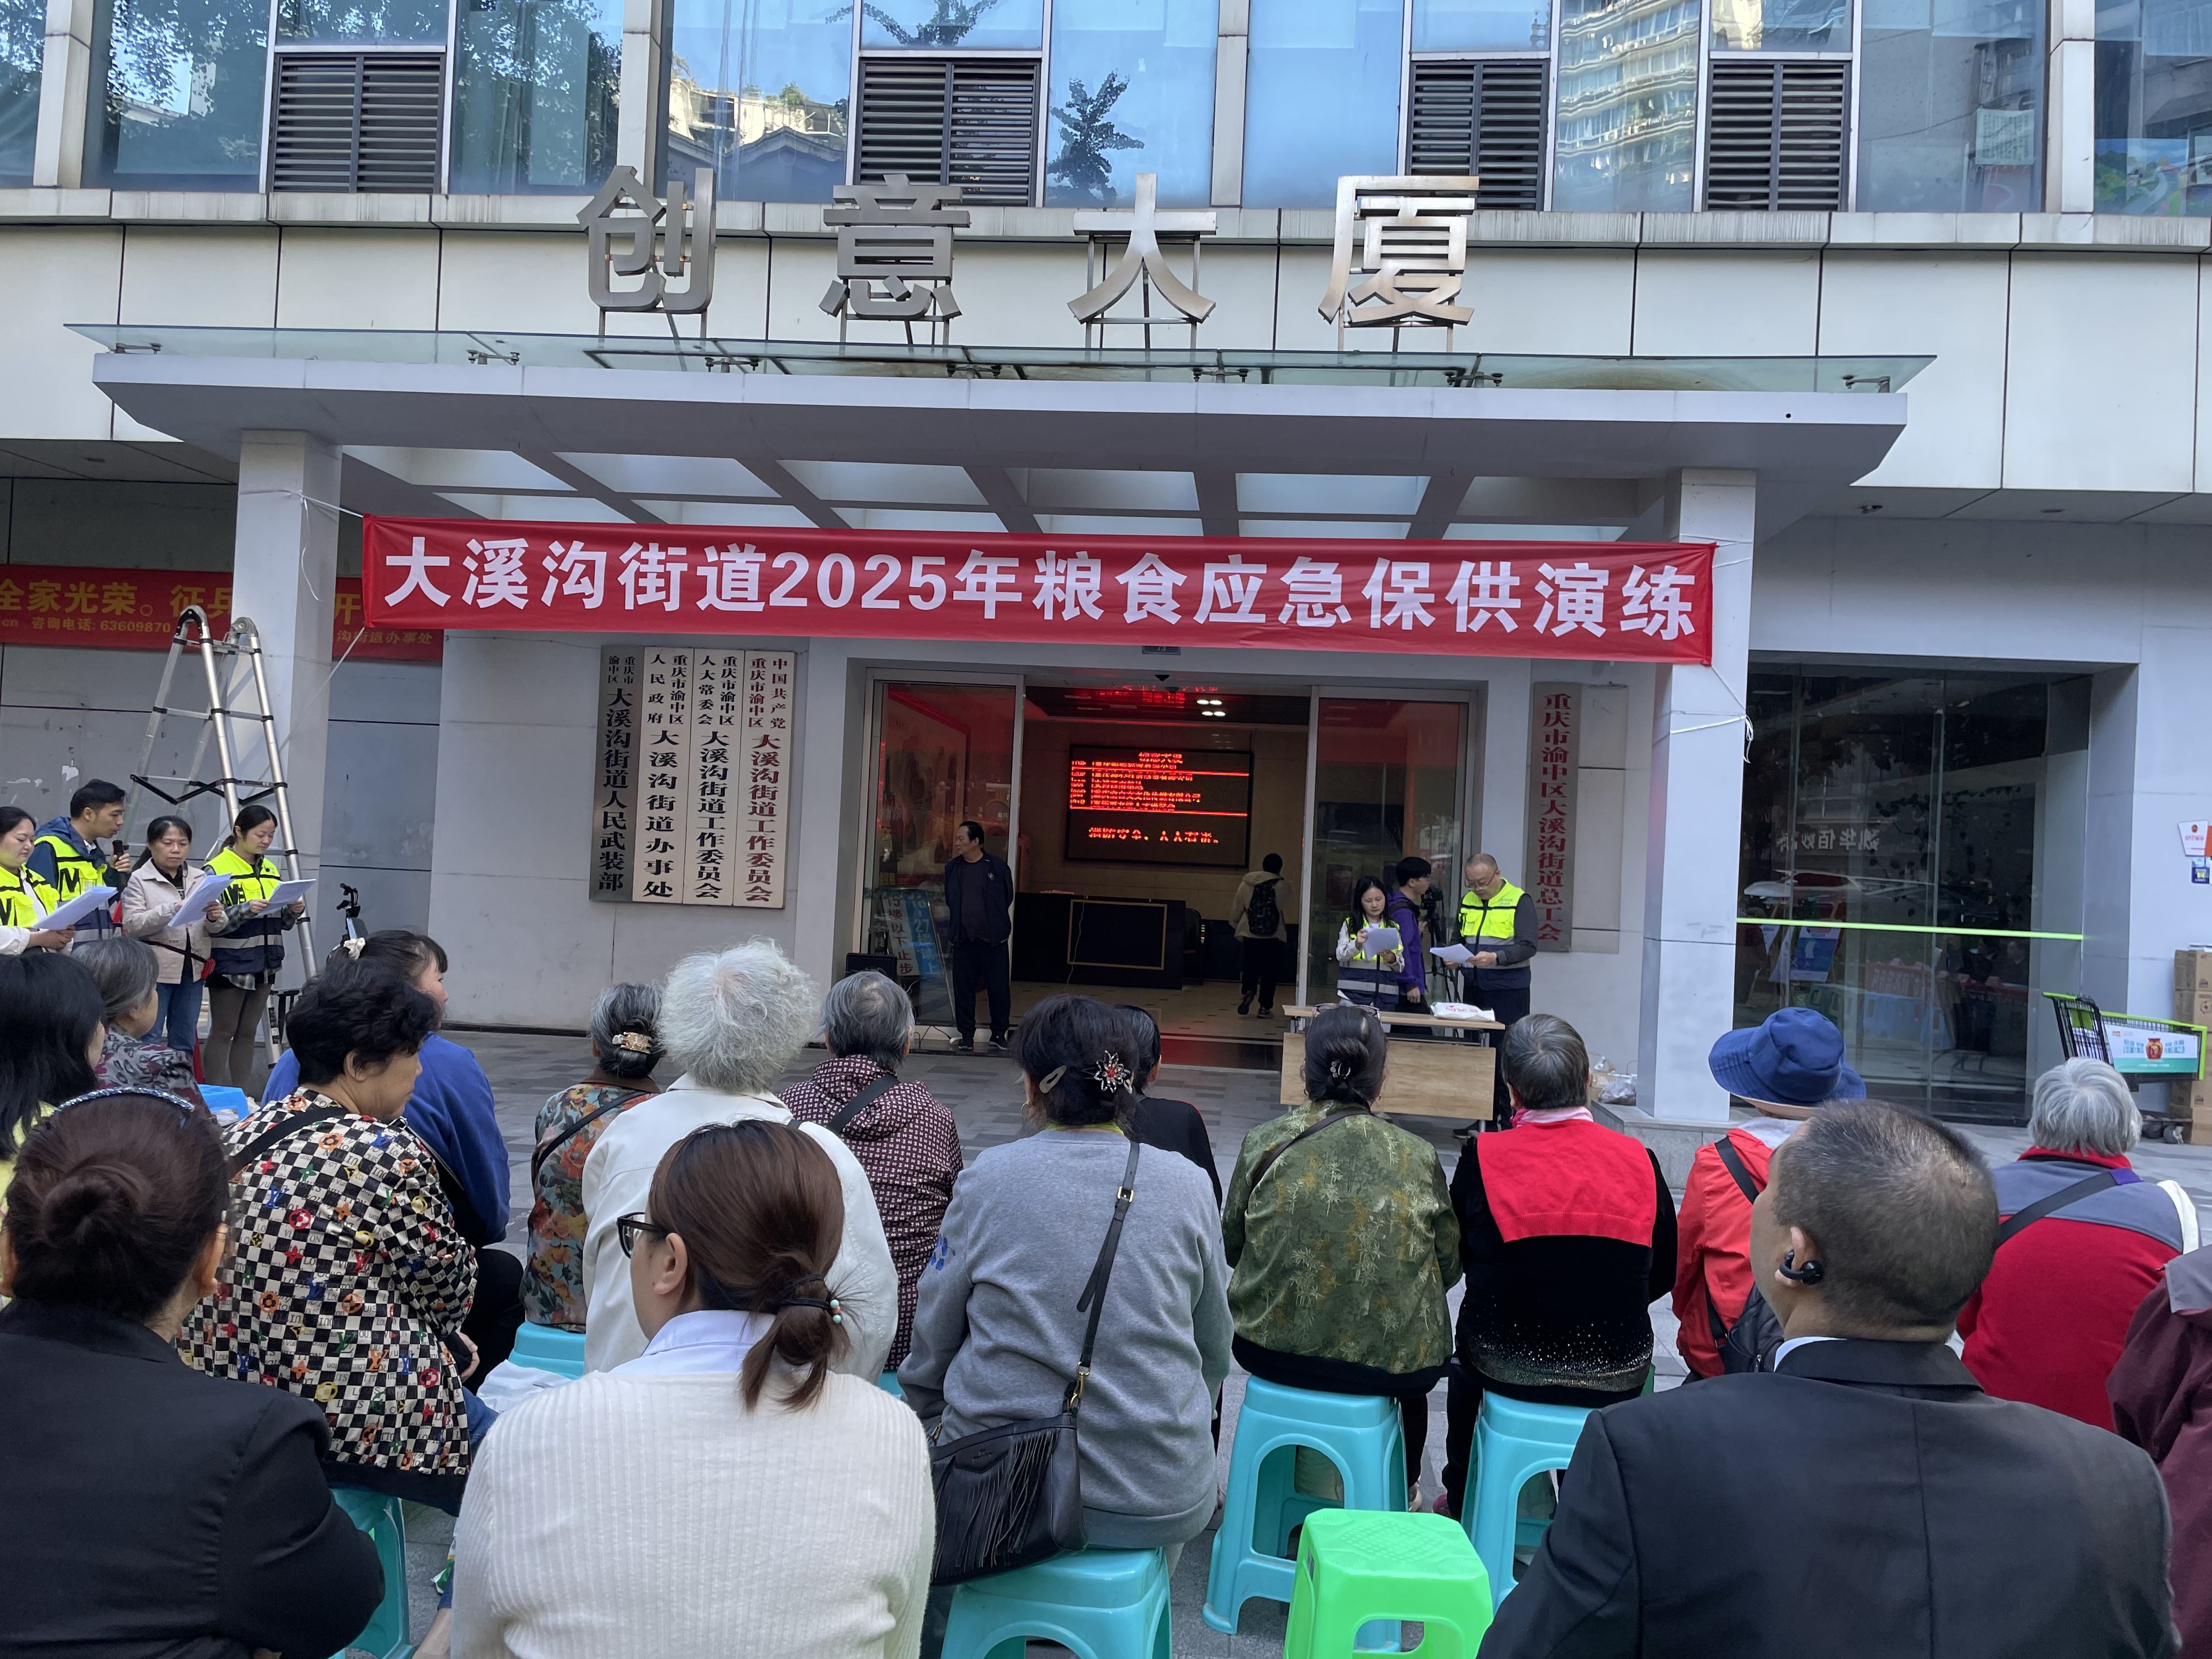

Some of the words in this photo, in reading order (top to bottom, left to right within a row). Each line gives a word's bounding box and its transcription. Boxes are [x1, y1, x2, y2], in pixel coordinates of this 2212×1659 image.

[577, 167, 1480, 326] 创意大厦
[385, 537, 1696, 640] 大溪沟街道2025年粮食应急保供演练
[100, 620, 171, 633] 63609870
[607, 655, 620, 684] 渝中区
[623, 656, 636, 685] 重庆市
[647, 653, 667, 724] 人民政府
[669, 654, 689, 725] 重庆市渝中区
[698, 654, 716, 725] 人大常委会
[719, 656, 738, 726] 重庆市渝中区
[748, 657, 766, 729] 重庆市渝中区
[770, 658, 788, 730] 中国共产党
[598, 687, 633, 892] 大溪沟街道人民武装部
[643, 730, 680, 898] 大溪沟街道办事处
[695, 731, 730, 899] 大溪沟街道工作委员会
[745, 734, 781, 902] 大溪沟街道工作委员会
[1536, 693, 1572, 942] 重庆市渝中区大溪沟街道总工会
